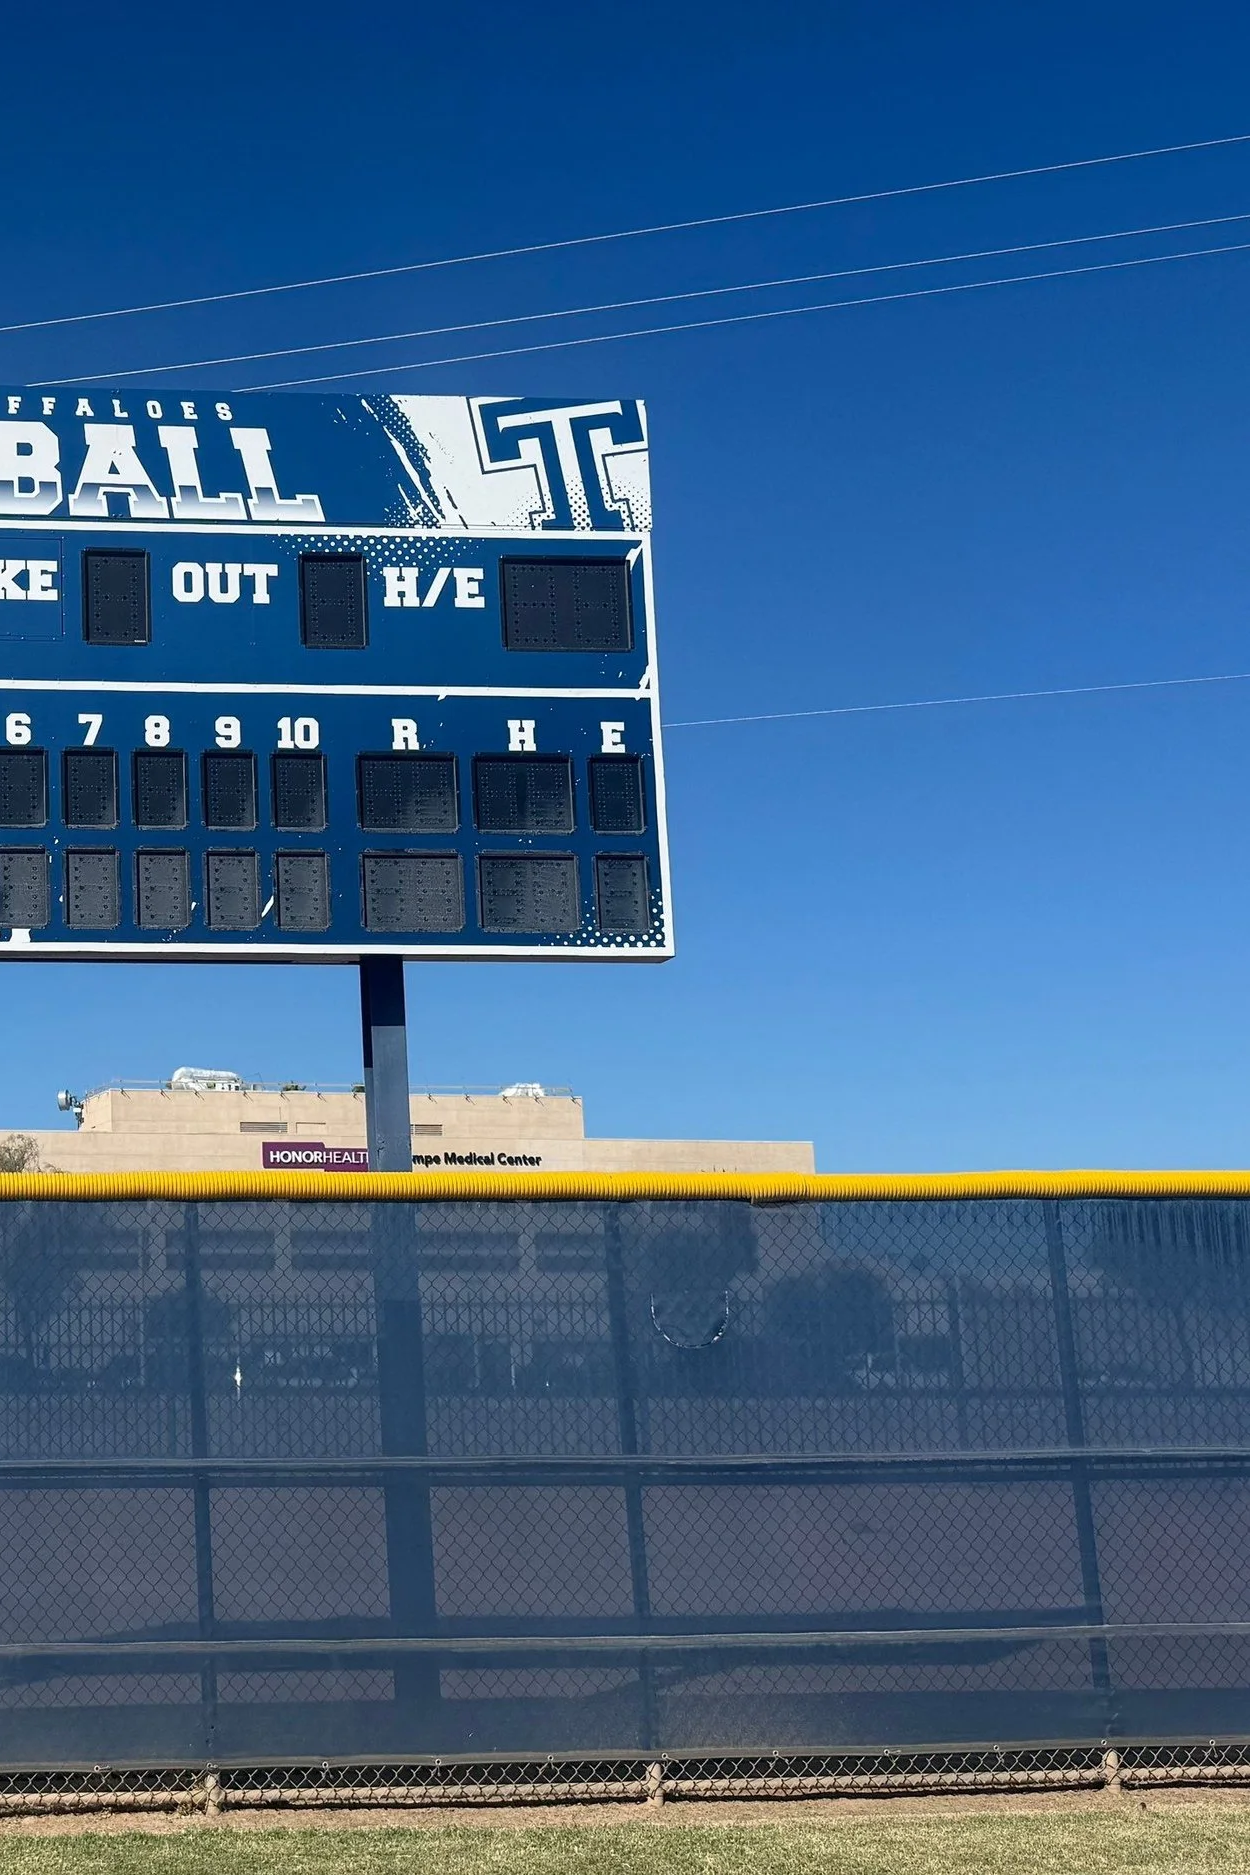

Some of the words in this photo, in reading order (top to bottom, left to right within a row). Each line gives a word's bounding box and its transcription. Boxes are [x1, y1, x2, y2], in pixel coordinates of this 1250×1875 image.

[172, 561, 279, 604] OUT
[382, 566, 485, 608] H/E
[5, 712, 32, 745] 6
[78, 713, 103, 746] 7
[144, 715, 170, 747] 8
[214, 716, 241, 749] 9
[277, 716, 320, 750] 10
[391, 718, 420, 751] R
[507, 719, 537, 752] H
[600, 721, 626, 754] E
[269, 1150, 369, 1164] HONORHEALT
[443, 1151, 495, 1165] Medical
[497, 1152, 542, 1166] Center
